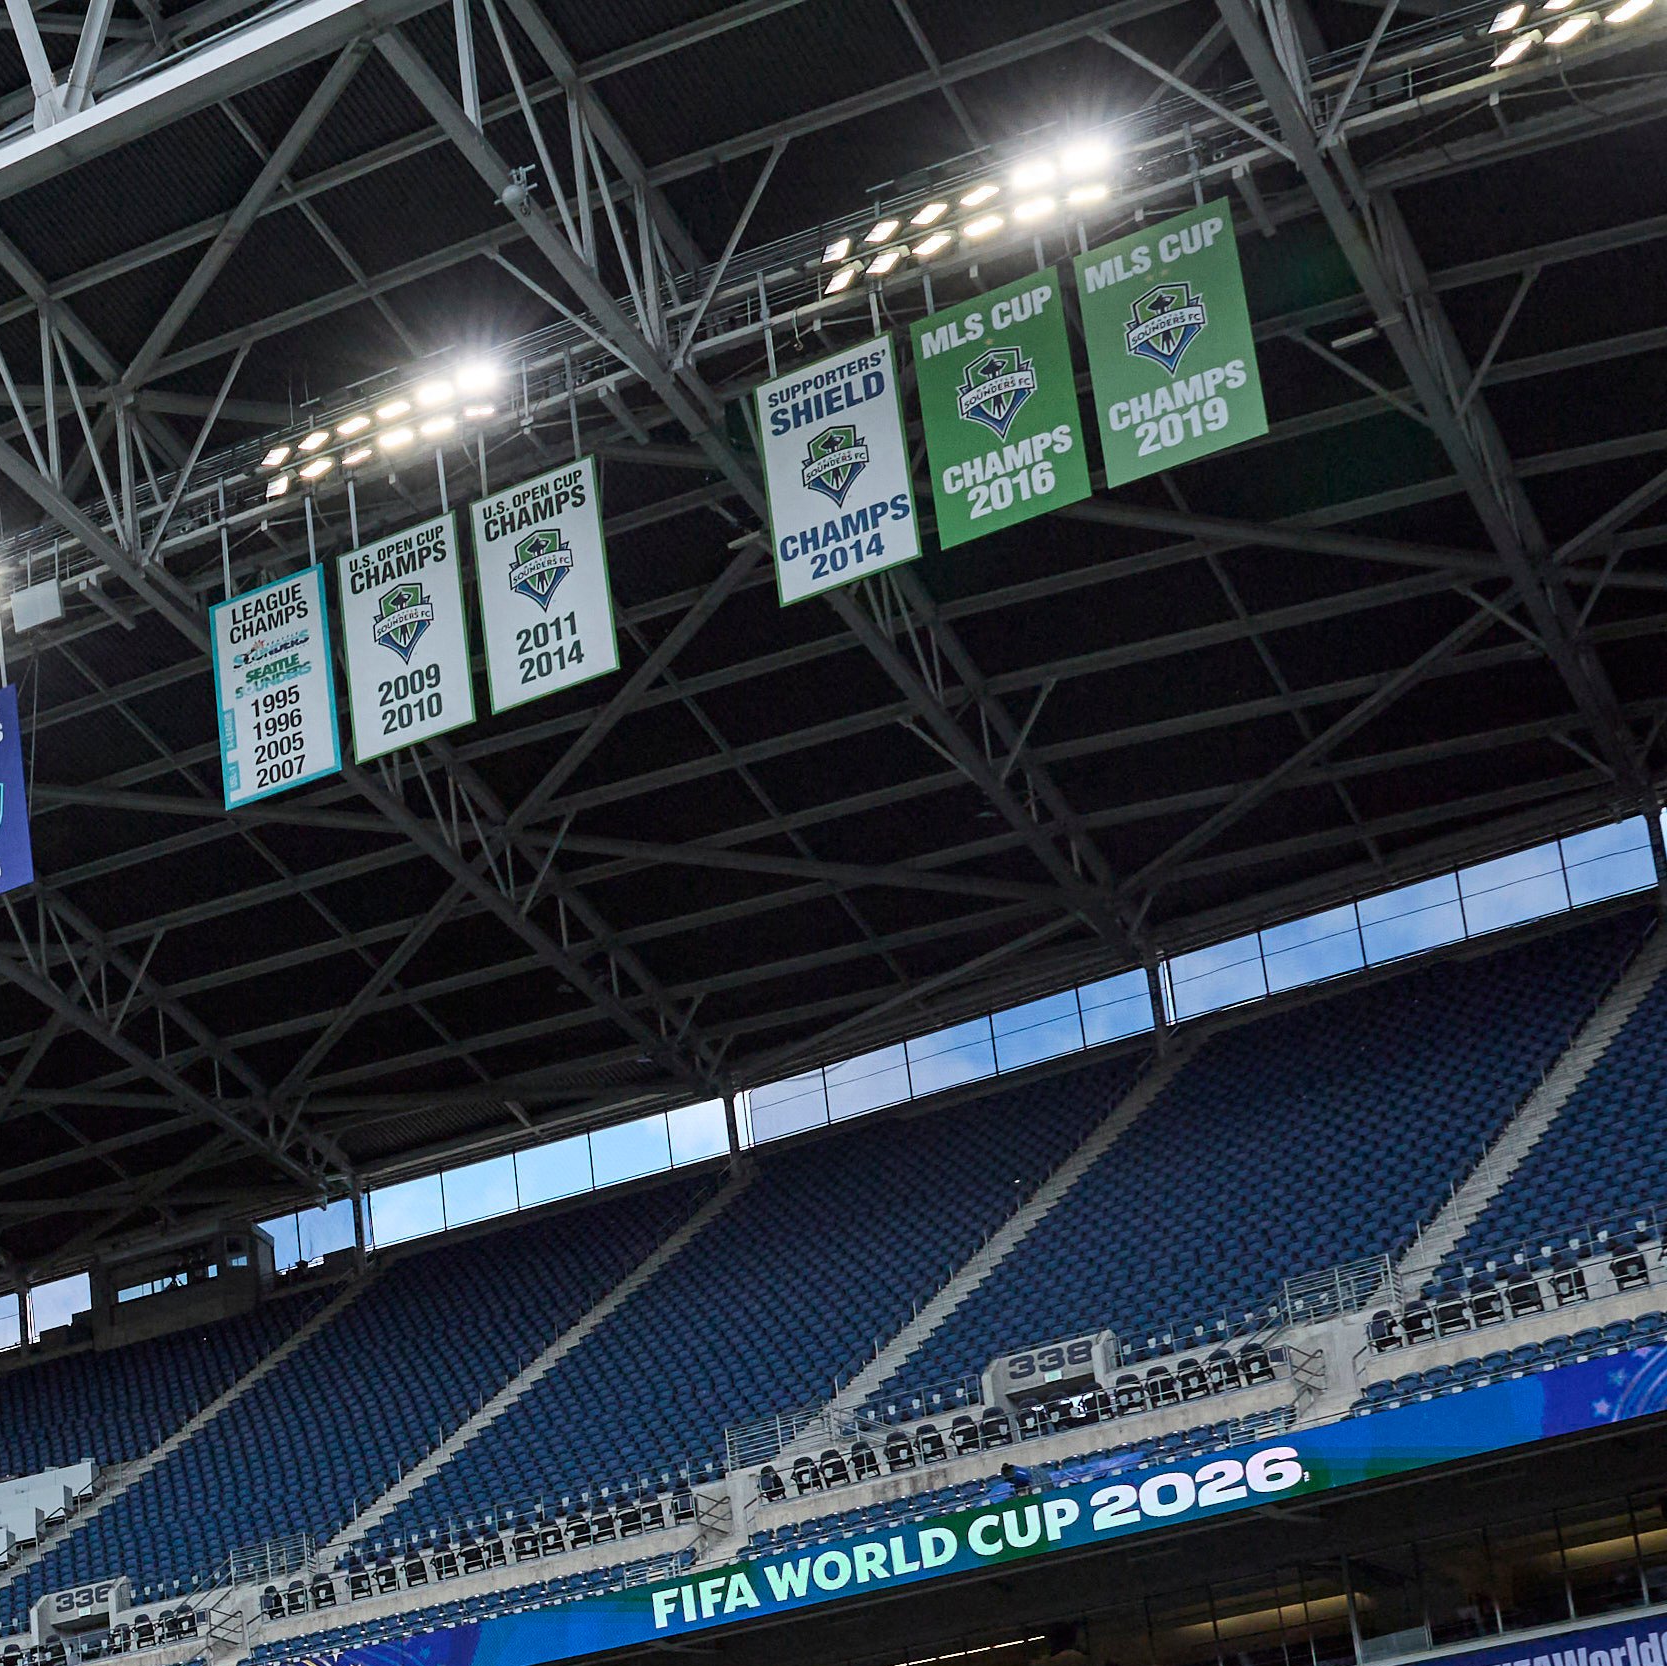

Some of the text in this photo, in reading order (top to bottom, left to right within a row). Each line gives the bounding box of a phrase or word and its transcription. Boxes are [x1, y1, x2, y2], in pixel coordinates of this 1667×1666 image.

[1084, 217, 1223, 294] MLS CUP
[921, 286, 1052, 359] MLS CUP
[1131, 313, 1186, 346] SOUNDERS
[1188, 311, 1201, 323] FC
[768, 350, 886, 408] SUPPORTERS'
[963, 378, 1017, 408] SOUNDERS
[1019, 376, 1031, 387] FC
[1108, 359, 1247, 431] CHAMPS
[771, 371, 885, 437] SHIELD
[1135, 396, 1229, 457] 2019
[806, 453, 852, 481] SOUNDERS
[854, 452, 866, 461] FC
[943, 424, 1073, 494] CHAMPS
[483, 470, 582, 520] U.S. OPEN CUP
[967, 461, 1055, 520] 2016
[485, 484, 585, 542] CHAMPS
[780, 493, 910, 562] CHAMPS
[349, 525, 444, 573] U.S. OPEN CUP
[350, 540, 447, 594] CHAMPS
[513, 557, 557, 583] SOUNDERS
[559, 556, 570, 566] FC
[811, 532, 885, 580] 2014
[230, 601, 308, 644] CHAMPS
[232, 583, 302, 625] LEAGUE
[376, 610, 419, 635] SOUNDERS
[420, 609, 431, 620] FC
[516, 611, 578, 655] 2011
[235, 661, 311, 699] SOUNDERS
[245, 653, 299, 682] SEATTLE
[520, 640, 584, 684] 2014
[251, 685, 299, 717] 1995
[379, 663, 441, 707] 2009
[253, 708, 302, 740] 1996
[381, 692, 443, 735] 2010
[255, 732, 304, 765] 2005
[257, 755, 305, 788] 2007
[1008, 1340, 1092, 1379] 338
[651, 1446, 1303, 1629] FIFA WORLD CUP 2026
